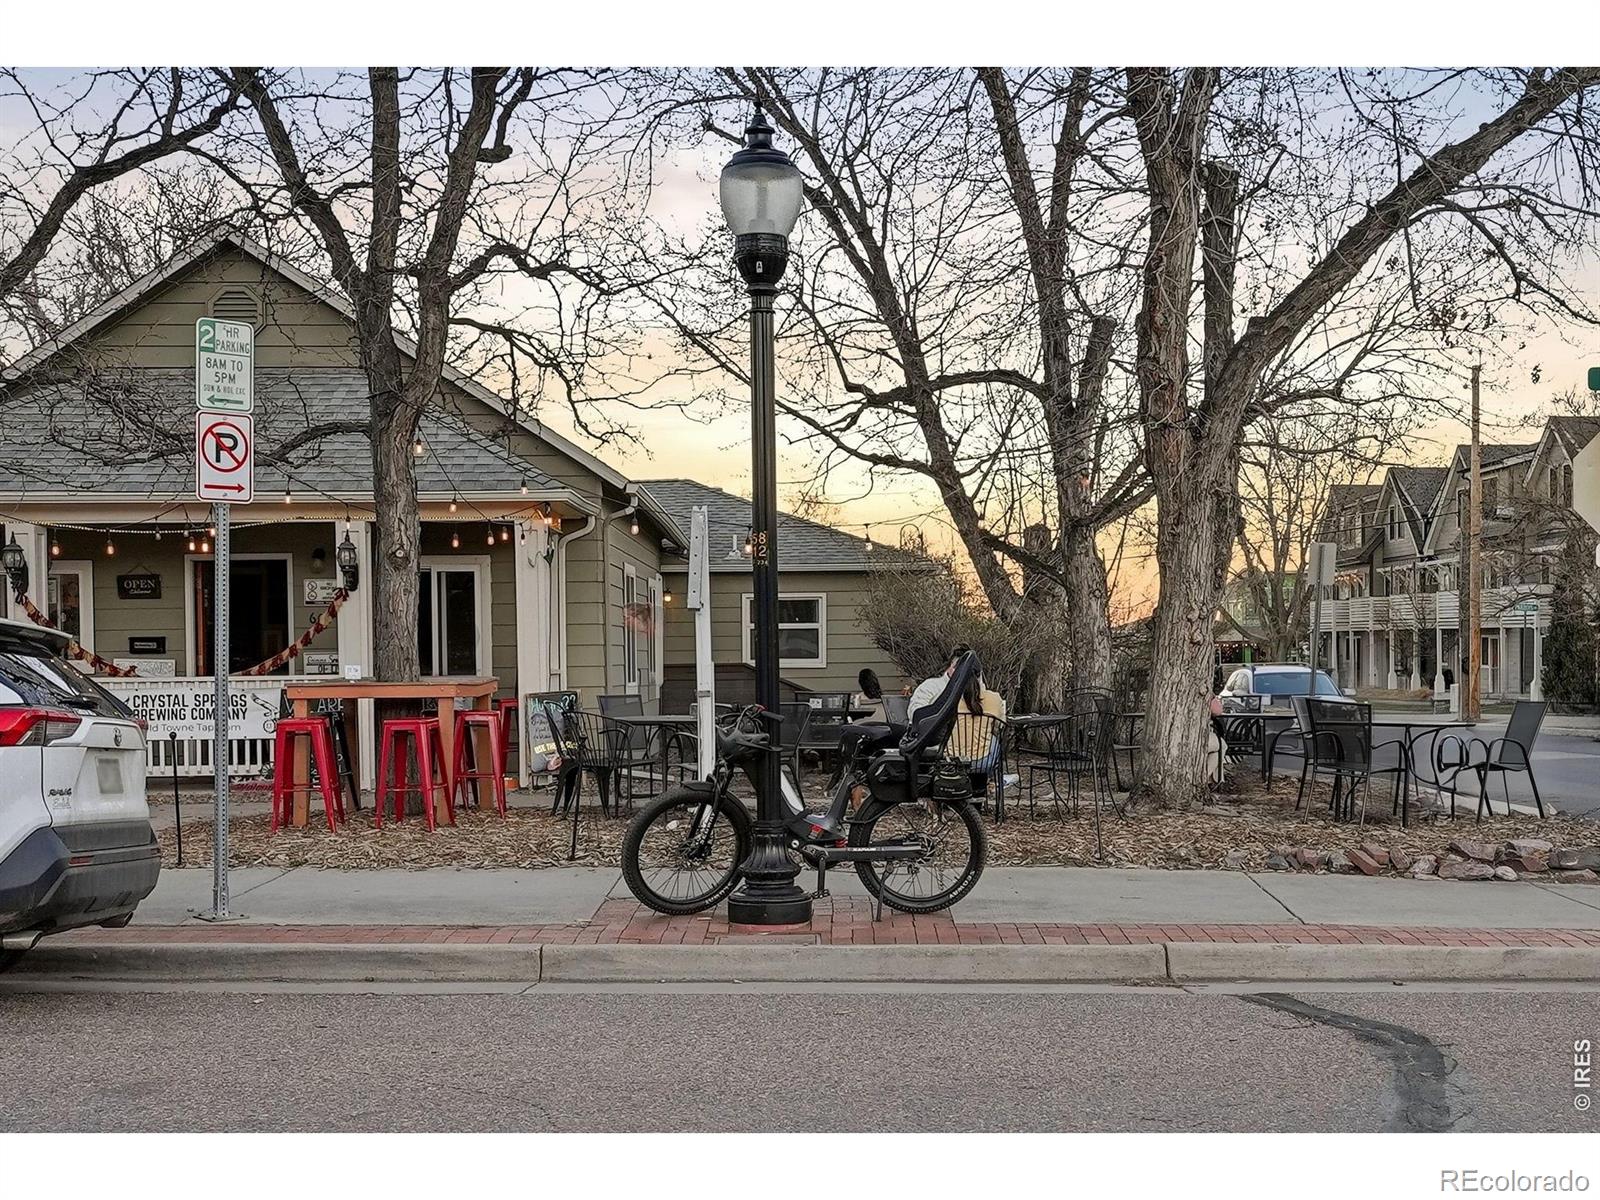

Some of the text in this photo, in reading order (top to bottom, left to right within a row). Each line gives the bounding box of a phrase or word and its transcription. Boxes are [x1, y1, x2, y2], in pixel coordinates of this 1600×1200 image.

[199, 325, 214, 348] 2
[226, 327, 240, 338] HR
[215, 340, 250, 354] PARKING
[205, 357, 243, 372] 8AM TO
[214, 372, 236, 384] 5PM
[123, 579, 156, 589] OPEN
[133, 694, 247, 708] CRYSTAL SPRGS
[132, 707, 248, 720] BREWING COMNY
[161, 723, 194, 732] Towne
[196, 723, 241, 732] Tapom
